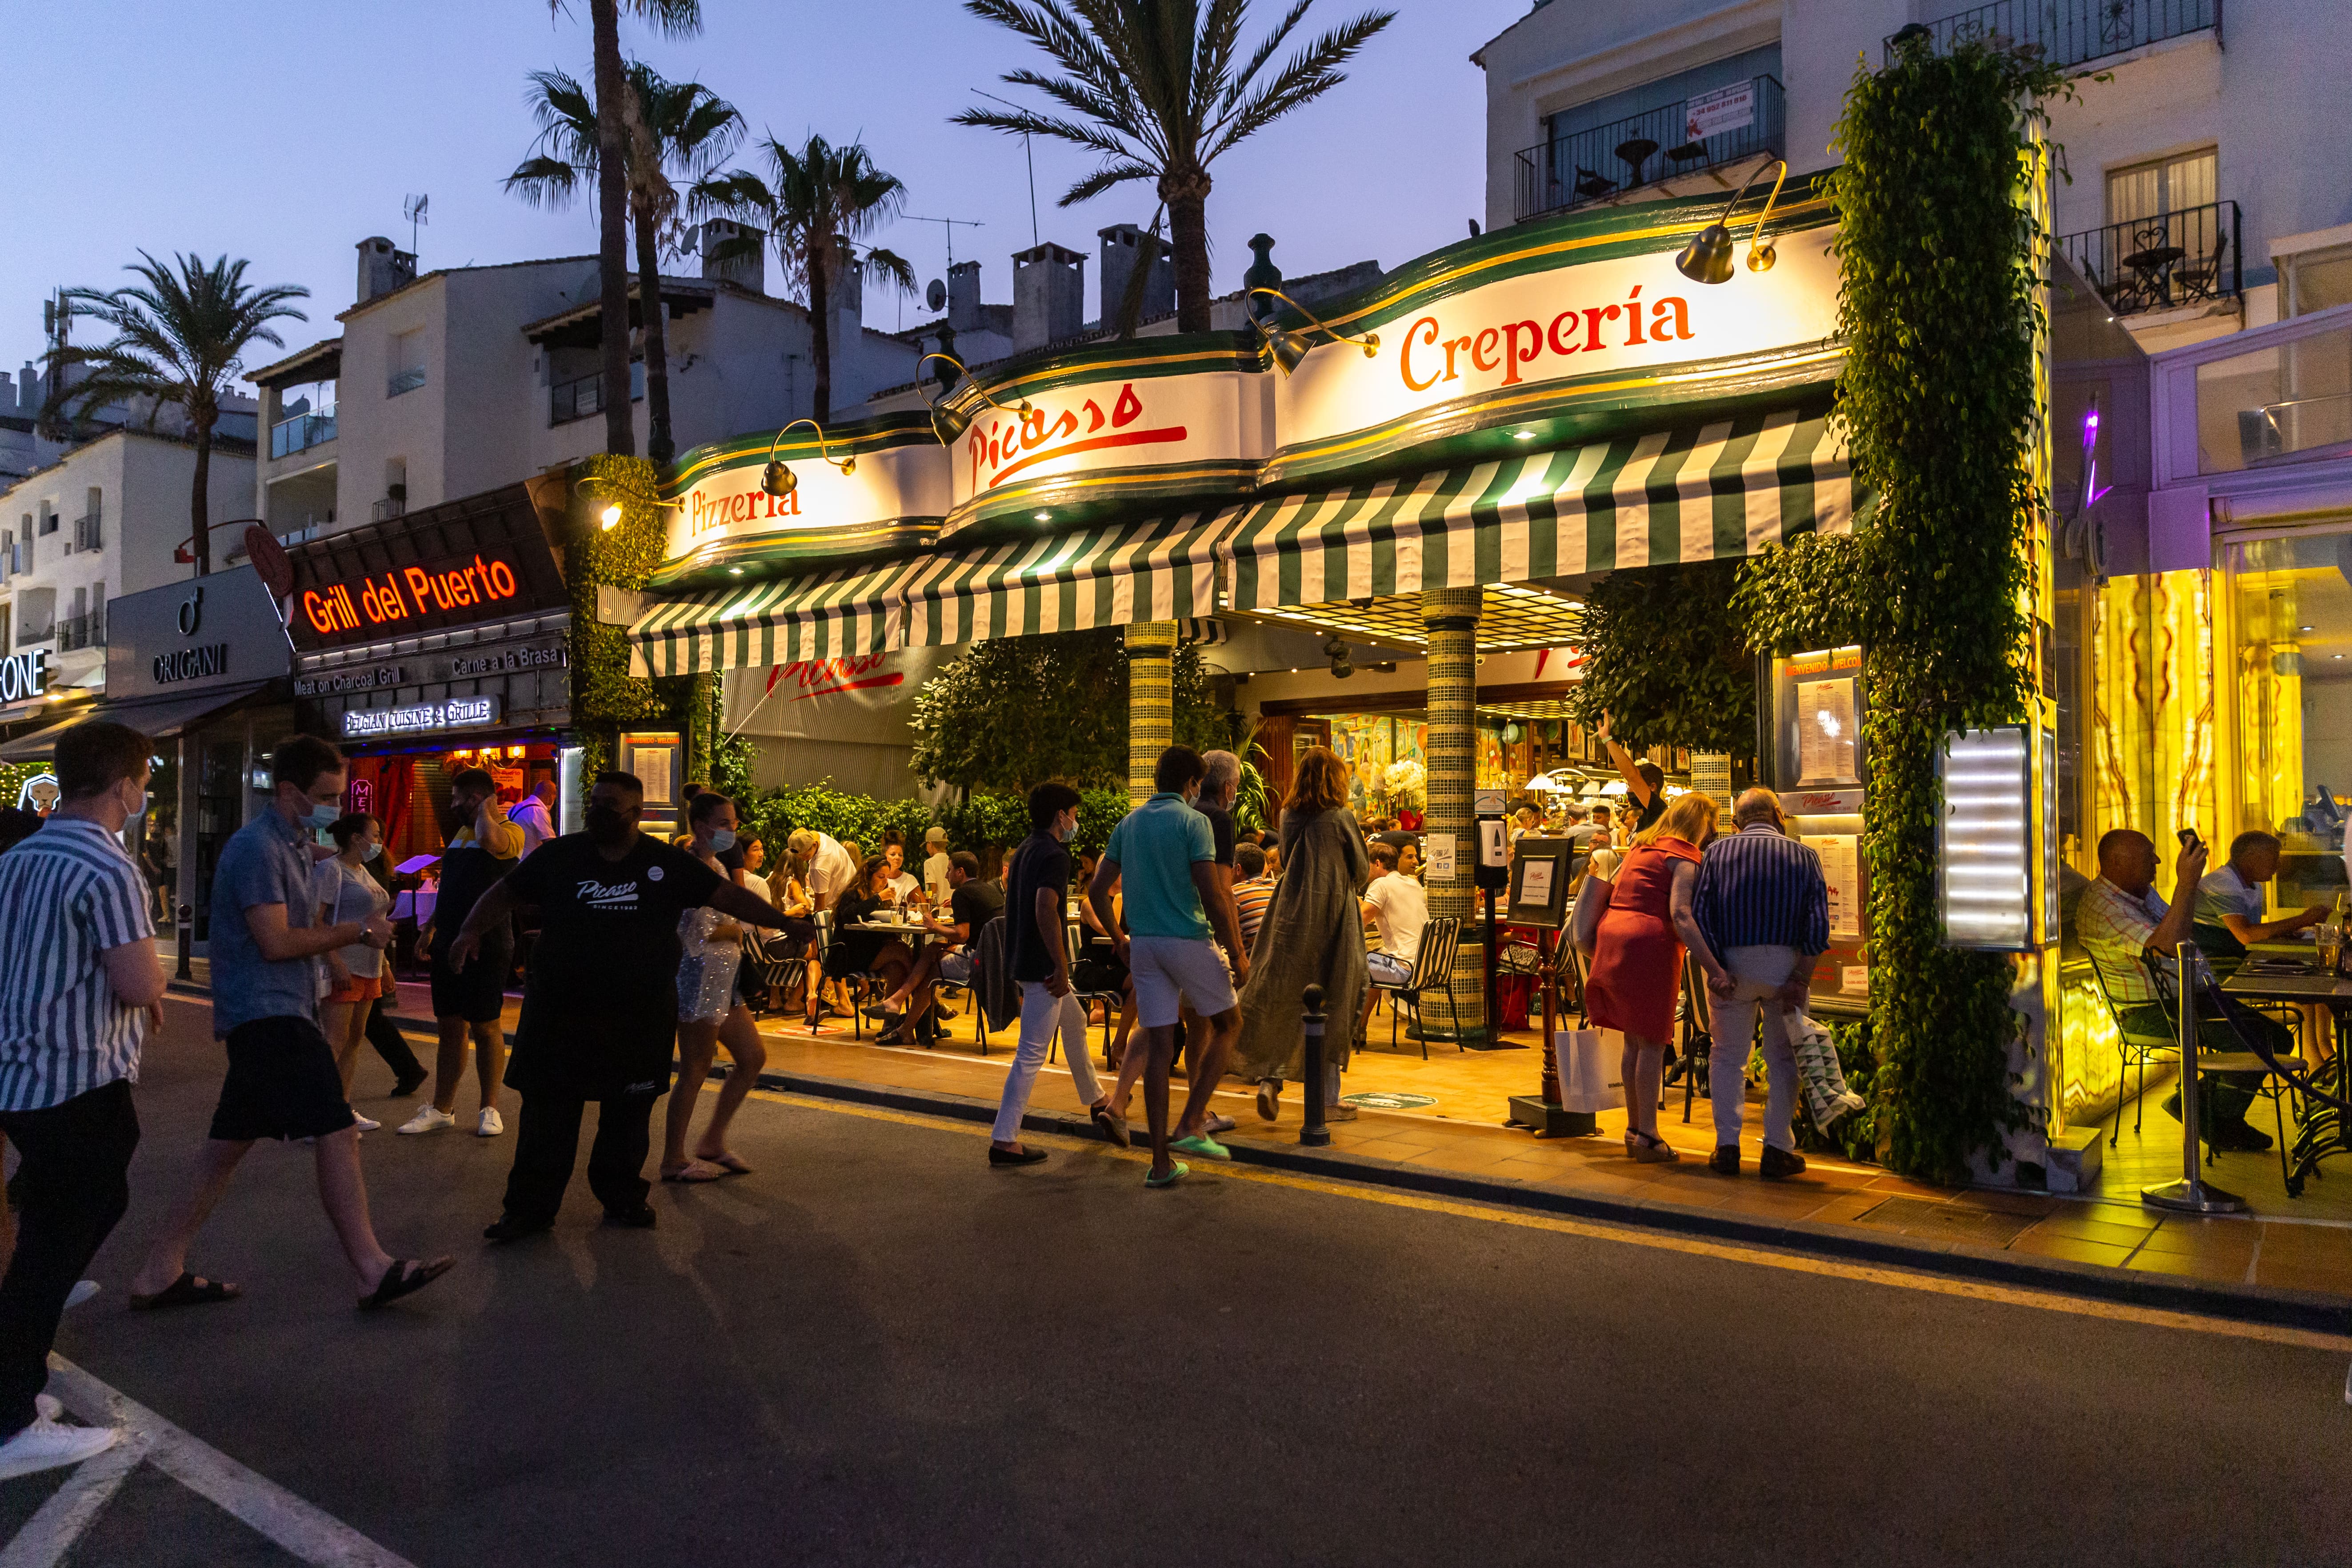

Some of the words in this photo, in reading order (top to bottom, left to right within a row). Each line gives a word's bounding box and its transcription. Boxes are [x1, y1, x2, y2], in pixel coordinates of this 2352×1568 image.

[1400, 285, 1695, 391] Crepería
[969, 384, 1143, 497] Picasso
[304, 584, 361, 642] Grill
[362, 572, 408, 624] del
[404, 554, 516, 613] Puerto
[0, 648, 44, 703] ONE
[153, 644, 221, 684] ORIGANI
[452, 657, 486, 675] Carne
[492, 657, 499, 670] a
[504, 652, 515, 668] la
[520, 648, 557, 666] Brasa
[1786, 661, 1828, 676] BIENVENIDO
[294, 680, 316, 696] Meat
[319, 680, 330, 692] on
[334, 671, 376, 691] Charcoal
[380, 667, 400, 685] Grill
[346, 714, 386, 732] BELGIAN
[388, 709, 430, 728] CUISINE
[435, 710, 443, 723] &
[448, 703, 488, 721] GRILLE
[577, 880, 637, 899] Picasso
